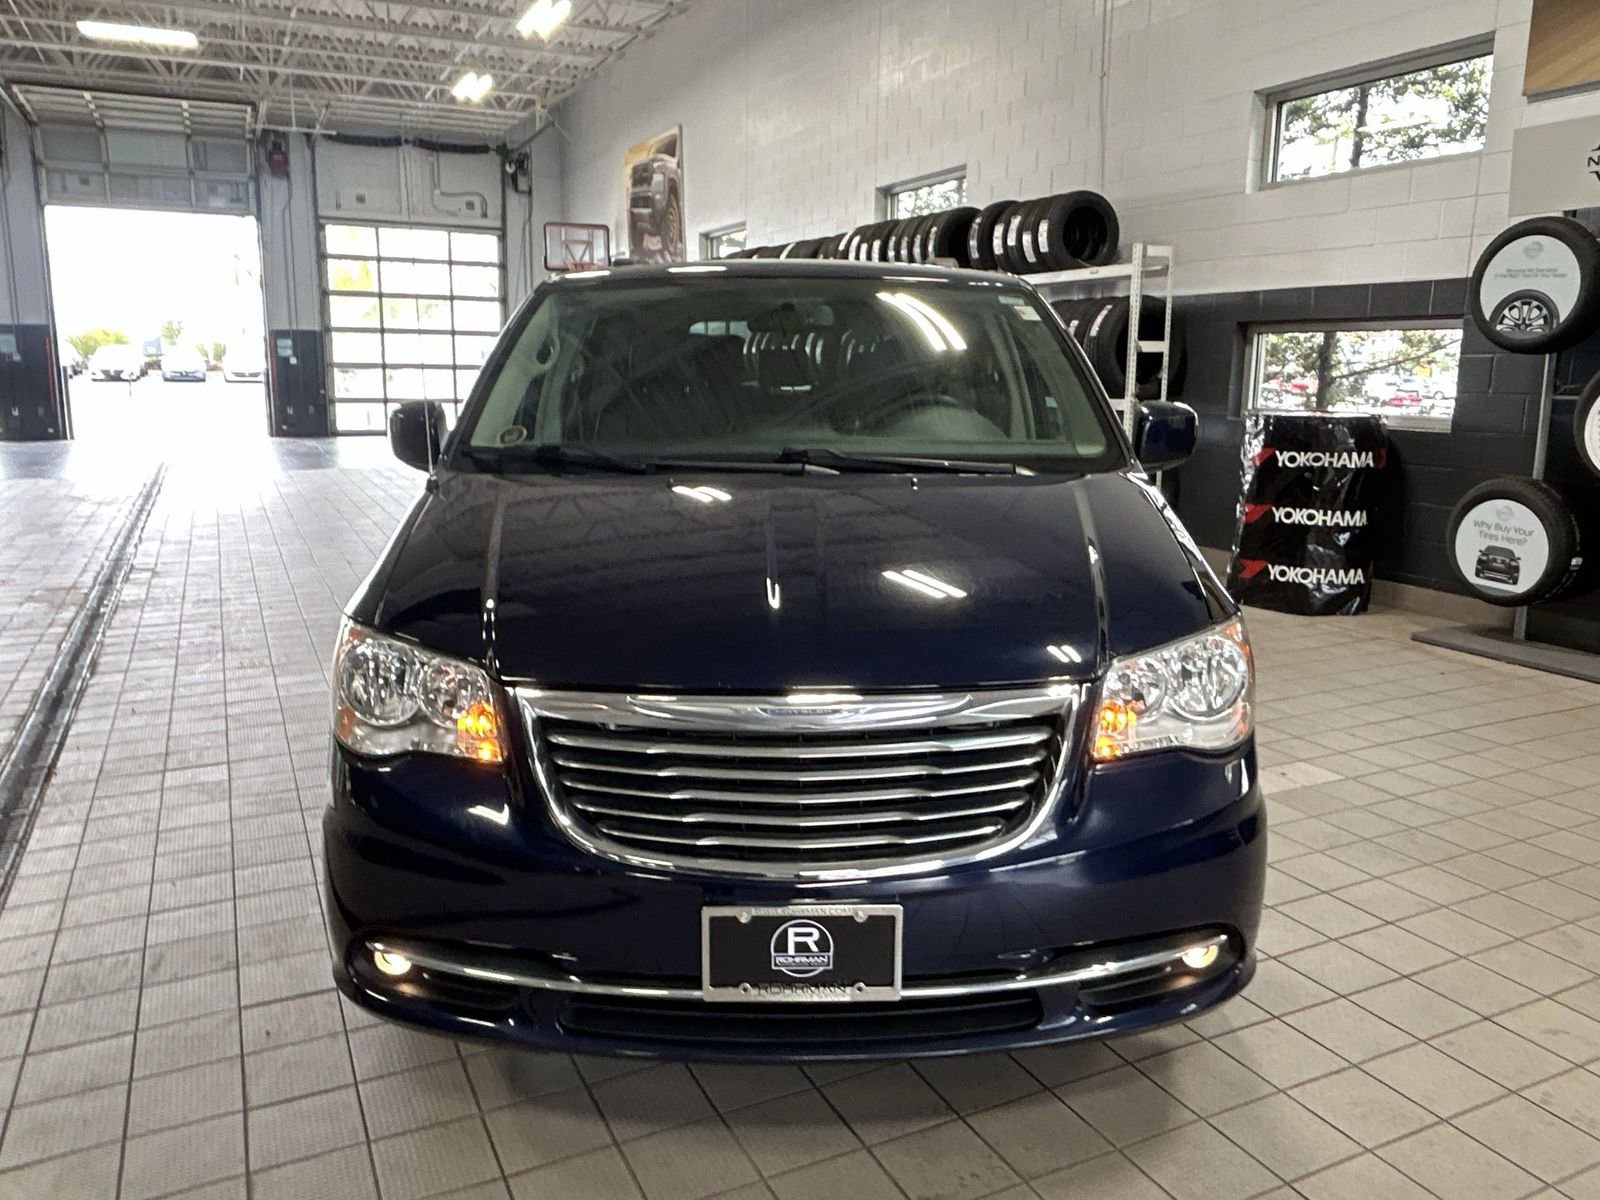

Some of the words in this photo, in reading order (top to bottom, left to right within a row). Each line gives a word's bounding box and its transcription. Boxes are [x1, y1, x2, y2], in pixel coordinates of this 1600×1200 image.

[1275, 450, 1374, 468] YOKOHAMA
[1271, 506, 1368, 527] YOKOHAMA
[1473, 520, 1493, 530] Why
[1494, 522, 1512, 534] Buy
[1514, 527, 1534, 537] Your
[1479, 530, 1499, 541] Tires
[1501, 535, 1527, 545] Here?
[1267, 563, 1365, 585] YOKOHAMA
[787, 926, 820, 956] R
[775, 955, 828, 966] ROHRMAN
